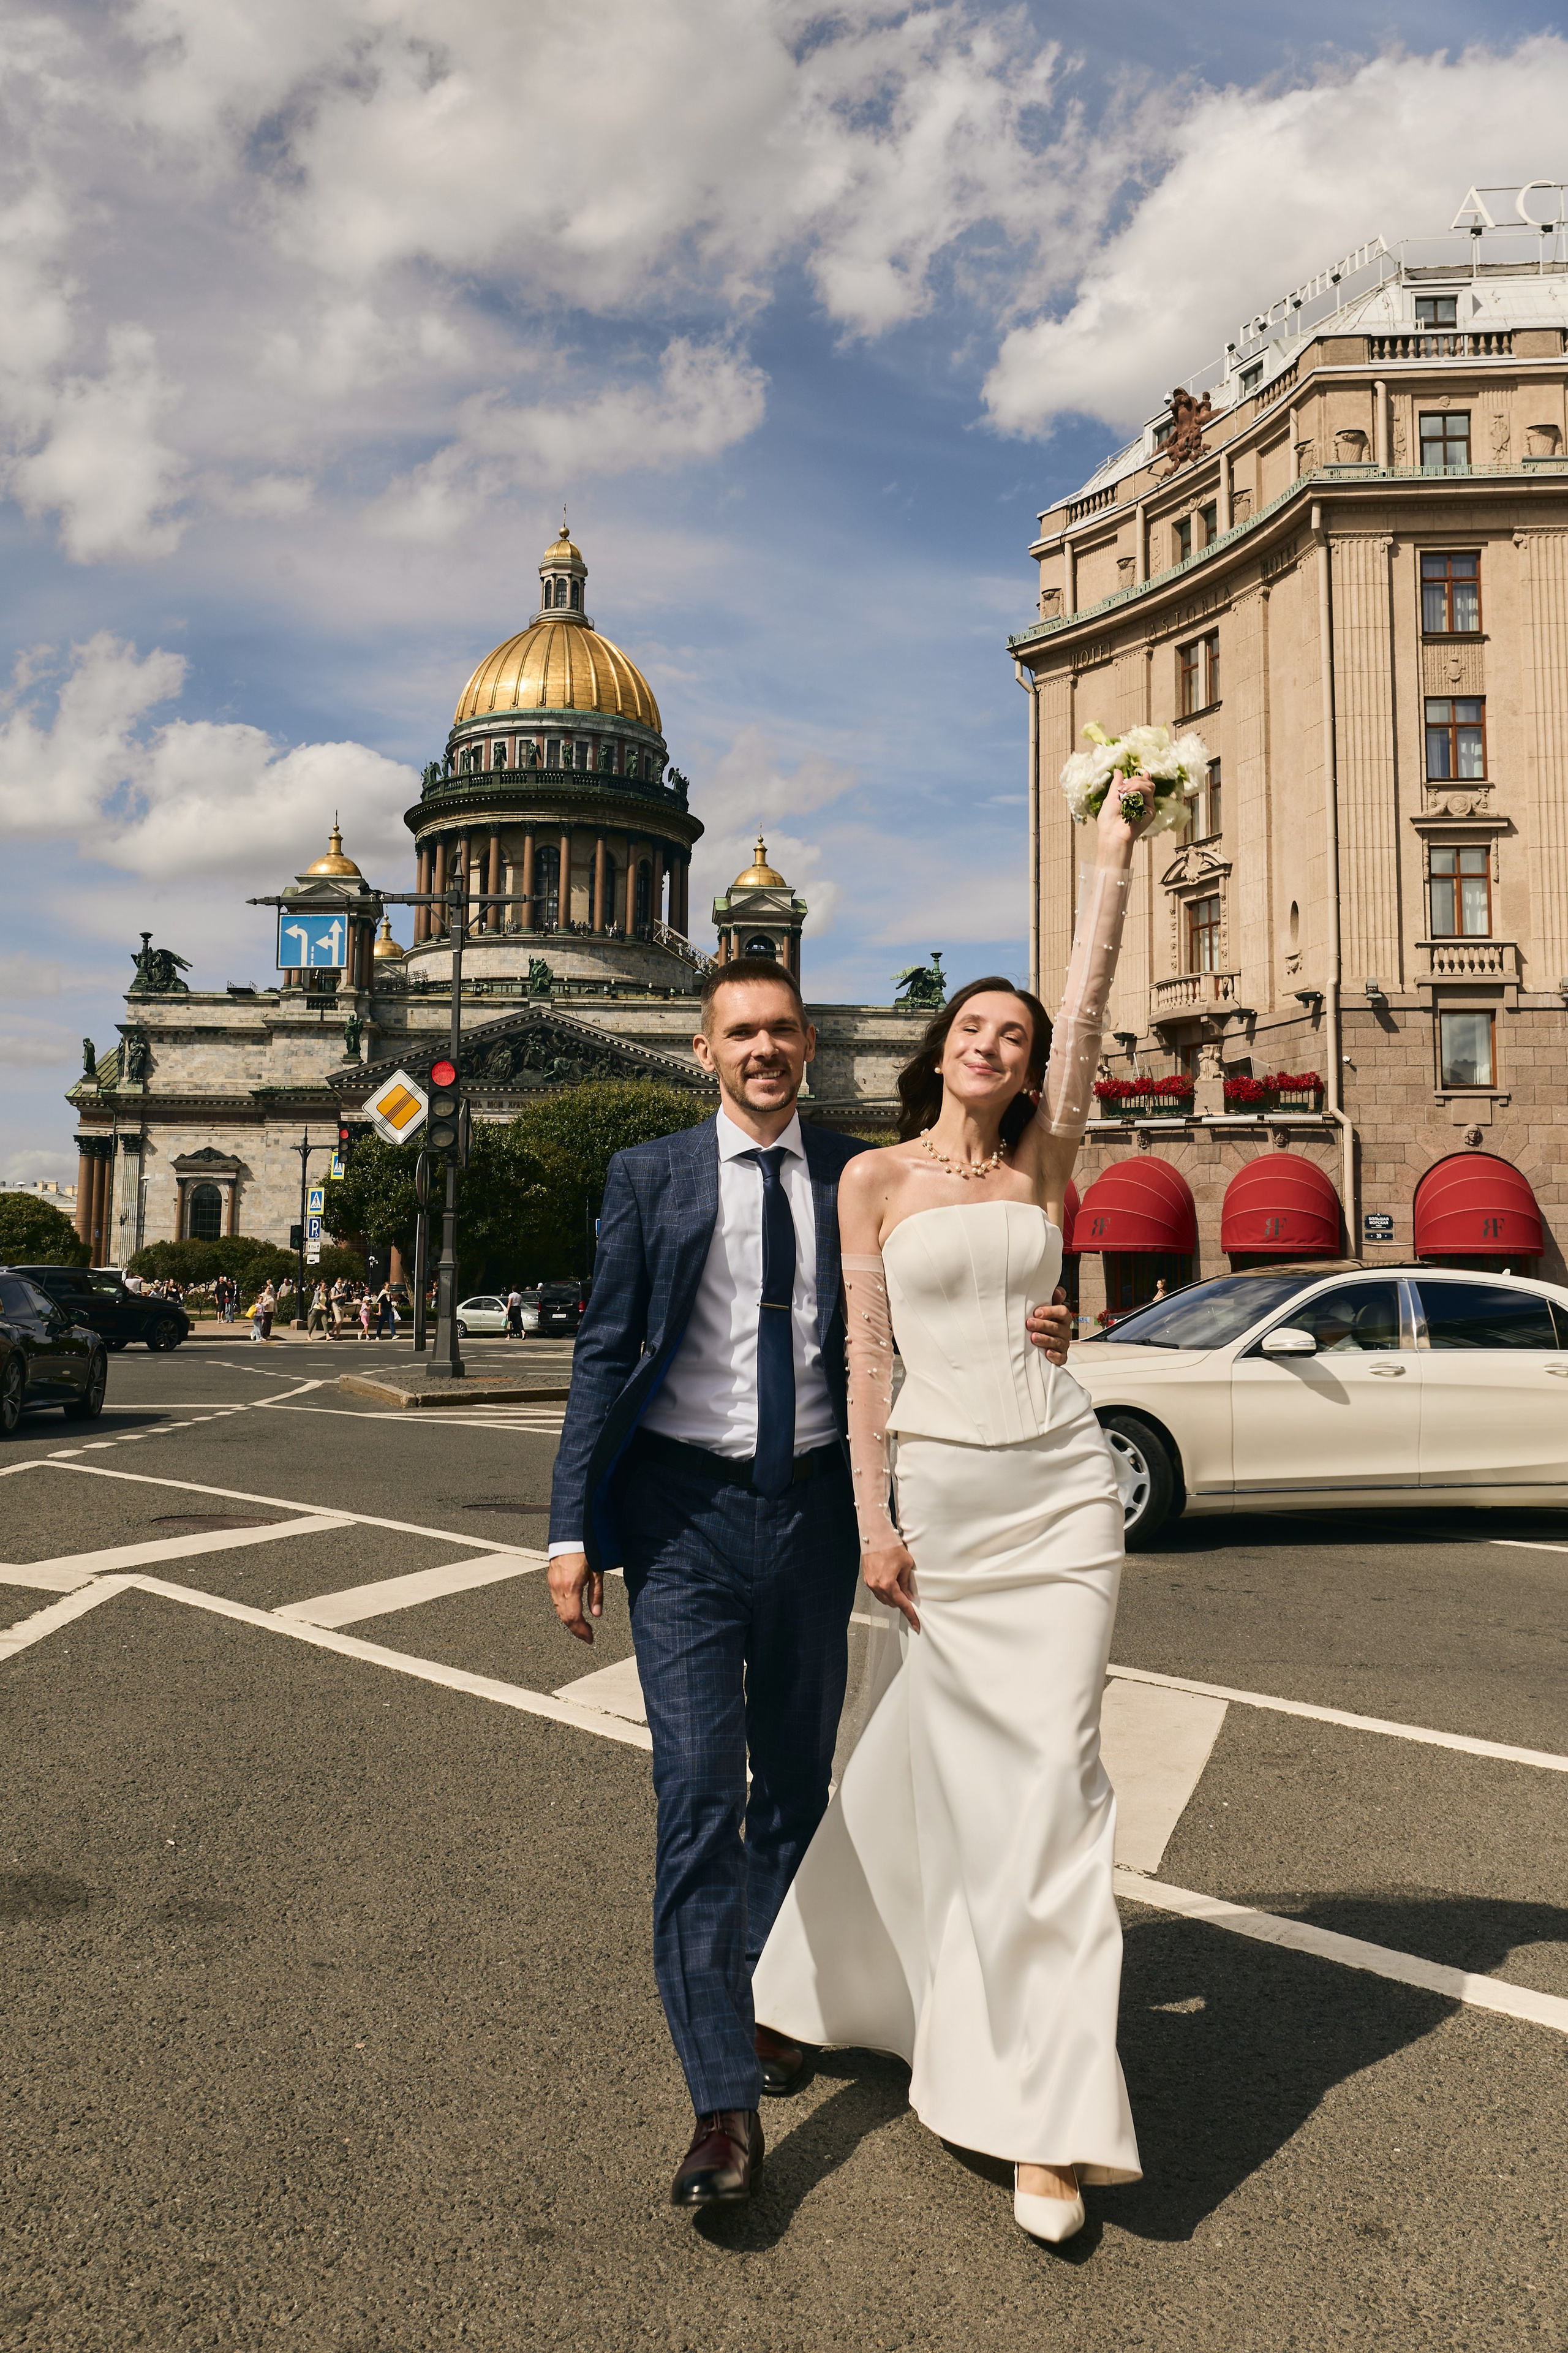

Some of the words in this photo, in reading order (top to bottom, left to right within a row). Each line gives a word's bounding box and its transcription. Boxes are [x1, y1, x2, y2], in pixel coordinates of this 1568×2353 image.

[1072, 643, 1111, 670] HOTEL
[1148, 586, 1231, 641] ASTORIA
[311, 1220, 318, 1236] P
